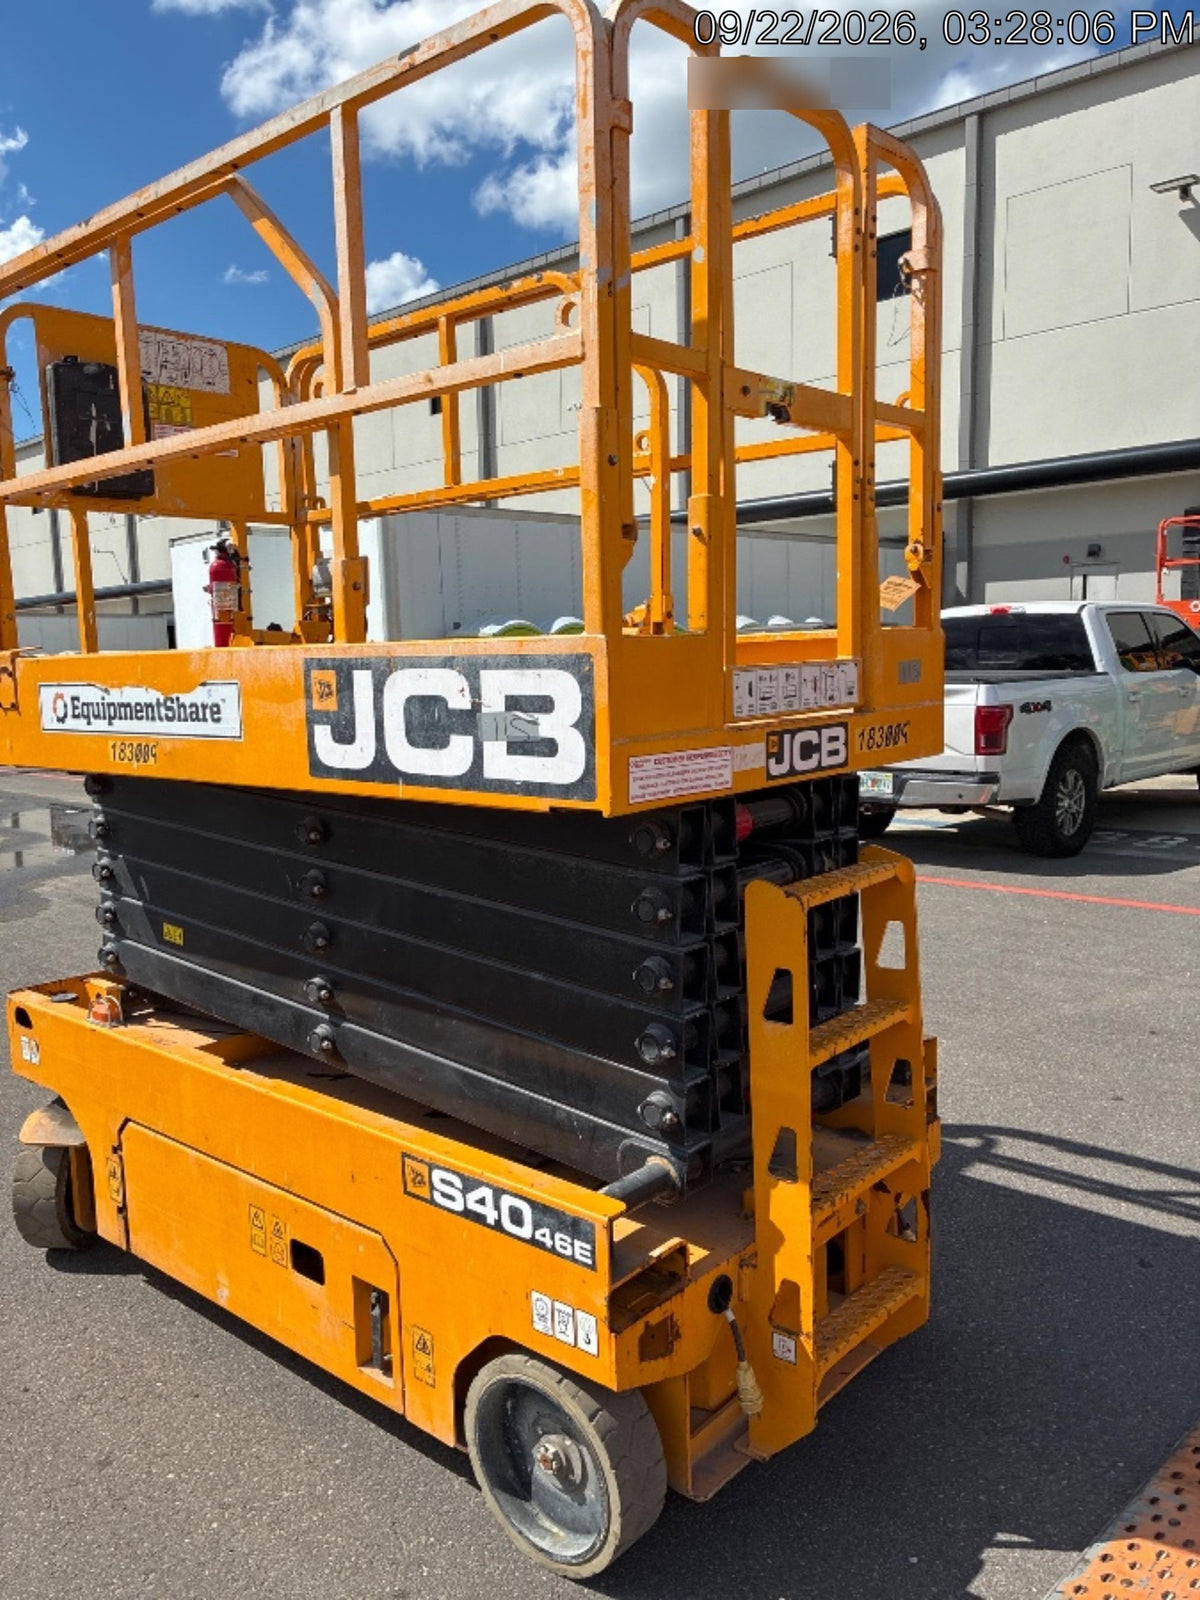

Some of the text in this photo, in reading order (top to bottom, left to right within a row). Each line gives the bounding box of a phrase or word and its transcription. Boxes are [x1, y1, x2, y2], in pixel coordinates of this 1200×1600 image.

[314, 668, 586, 785] JCB
[767, 726, 848, 777] JCB
[431, 1168, 593, 1266] S40 46E
